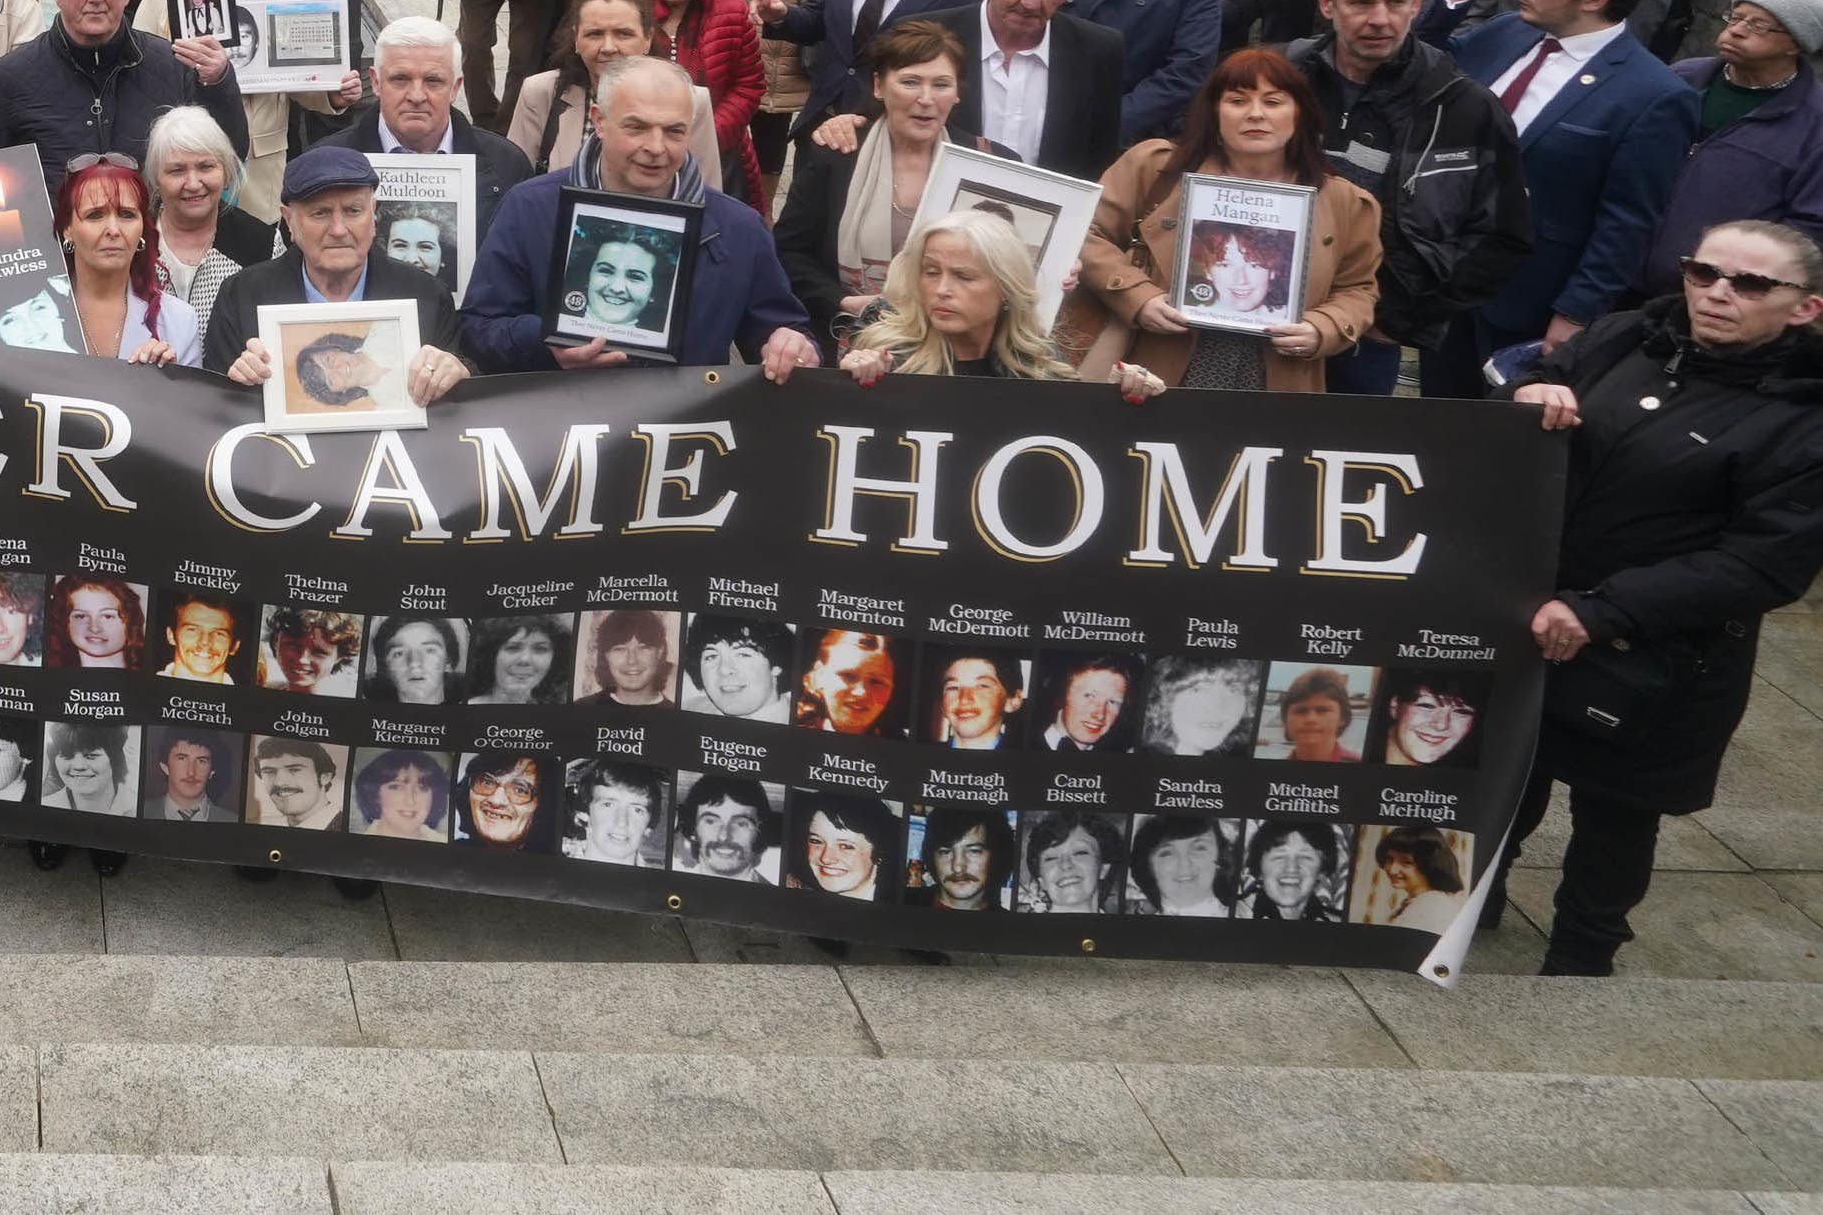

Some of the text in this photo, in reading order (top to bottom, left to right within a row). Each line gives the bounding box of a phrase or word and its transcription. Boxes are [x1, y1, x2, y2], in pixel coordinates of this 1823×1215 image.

[380, 171, 446, 185] Kathleen
[380, 185, 446, 198] Muldoon
[1216, 188, 1274, 208] Helena
[1213, 204, 1280, 225] Mangan
[204, 419, 740, 546] CAME
[808, 424, 1429, 580] HOME
[78, 542, 125, 564] Paula
[78, 553, 127, 573] Byrne
[178, 560, 237, 583] Jimmy
[174, 567, 241, 594] Buckley
[284, 574, 348, 595] Thelma
[486, 580, 574, 600] Jacqueline
[599, 574, 668, 593] Marcella
[708, 577, 779, 599] Michael
[289, 586, 343, 604] Frazer
[402, 584, 446, 597] John
[503, 590, 558, 609] Croker
[586, 588, 679, 602] McDermott
[708, 588, 779, 611] Ffrench
[400, 596, 445, 610] Stout
[817, 588, 905, 616] Margaret
[817, 602, 905, 627] Thornton
[949, 603, 1013, 626] George
[1062, 611, 1130, 628] William
[929, 616, 1029, 638] McDermott
[1044, 624, 1145, 643] McDermott
[1188, 617, 1239, 634] Paula
[1301, 624, 1361, 643] Robert
[1186, 633, 1237, 649] Lewis
[1419, 629, 1479, 646] Teresa
[1307, 639, 1352, 658] Kelly
[1399, 644, 1493, 660] McDonnell
[69, 688, 121, 702] Susan
[64, 702, 125, 720] Morgan
[162, 704, 232, 725] McGrath
[167, 696, 226, 716] Gerard
[280, 710, 323, 725] John
[273, 718, 329, 737] Colgan
[372, 719, 445, 741] Margaret
[375, 727, 440, 746] Kiernan
[484, 725, 544, 743] George
[597, 727, 645, 744] David
[474, 738, 551, 750] O'Connor
[597, 739, 642, 756] Flood
[700, 735, 767, 760] Eugene
[703, 748, 764, 772] Hogan
[821, 753, 876, 777] Marie
[806, 764, 889, 794] Kennedy
[927, 769, 1005, 792] Murtagh
[1053, 773, 1101, 793] Carol
[1158, 778, 1222, 794] Sandra
[922, 781, 1009, 805] Kavanagh
[1046, 788, 1106, 804] Bissett
[1155, 792, 1224, 809] Lawless
[1266, 782, 1339, 803] Michael
[1380, 788, 1458, 808] Caroline
[1265, 797, 1339, 814] Griffiths
[1379, 803, 1455, 822] McHugh
